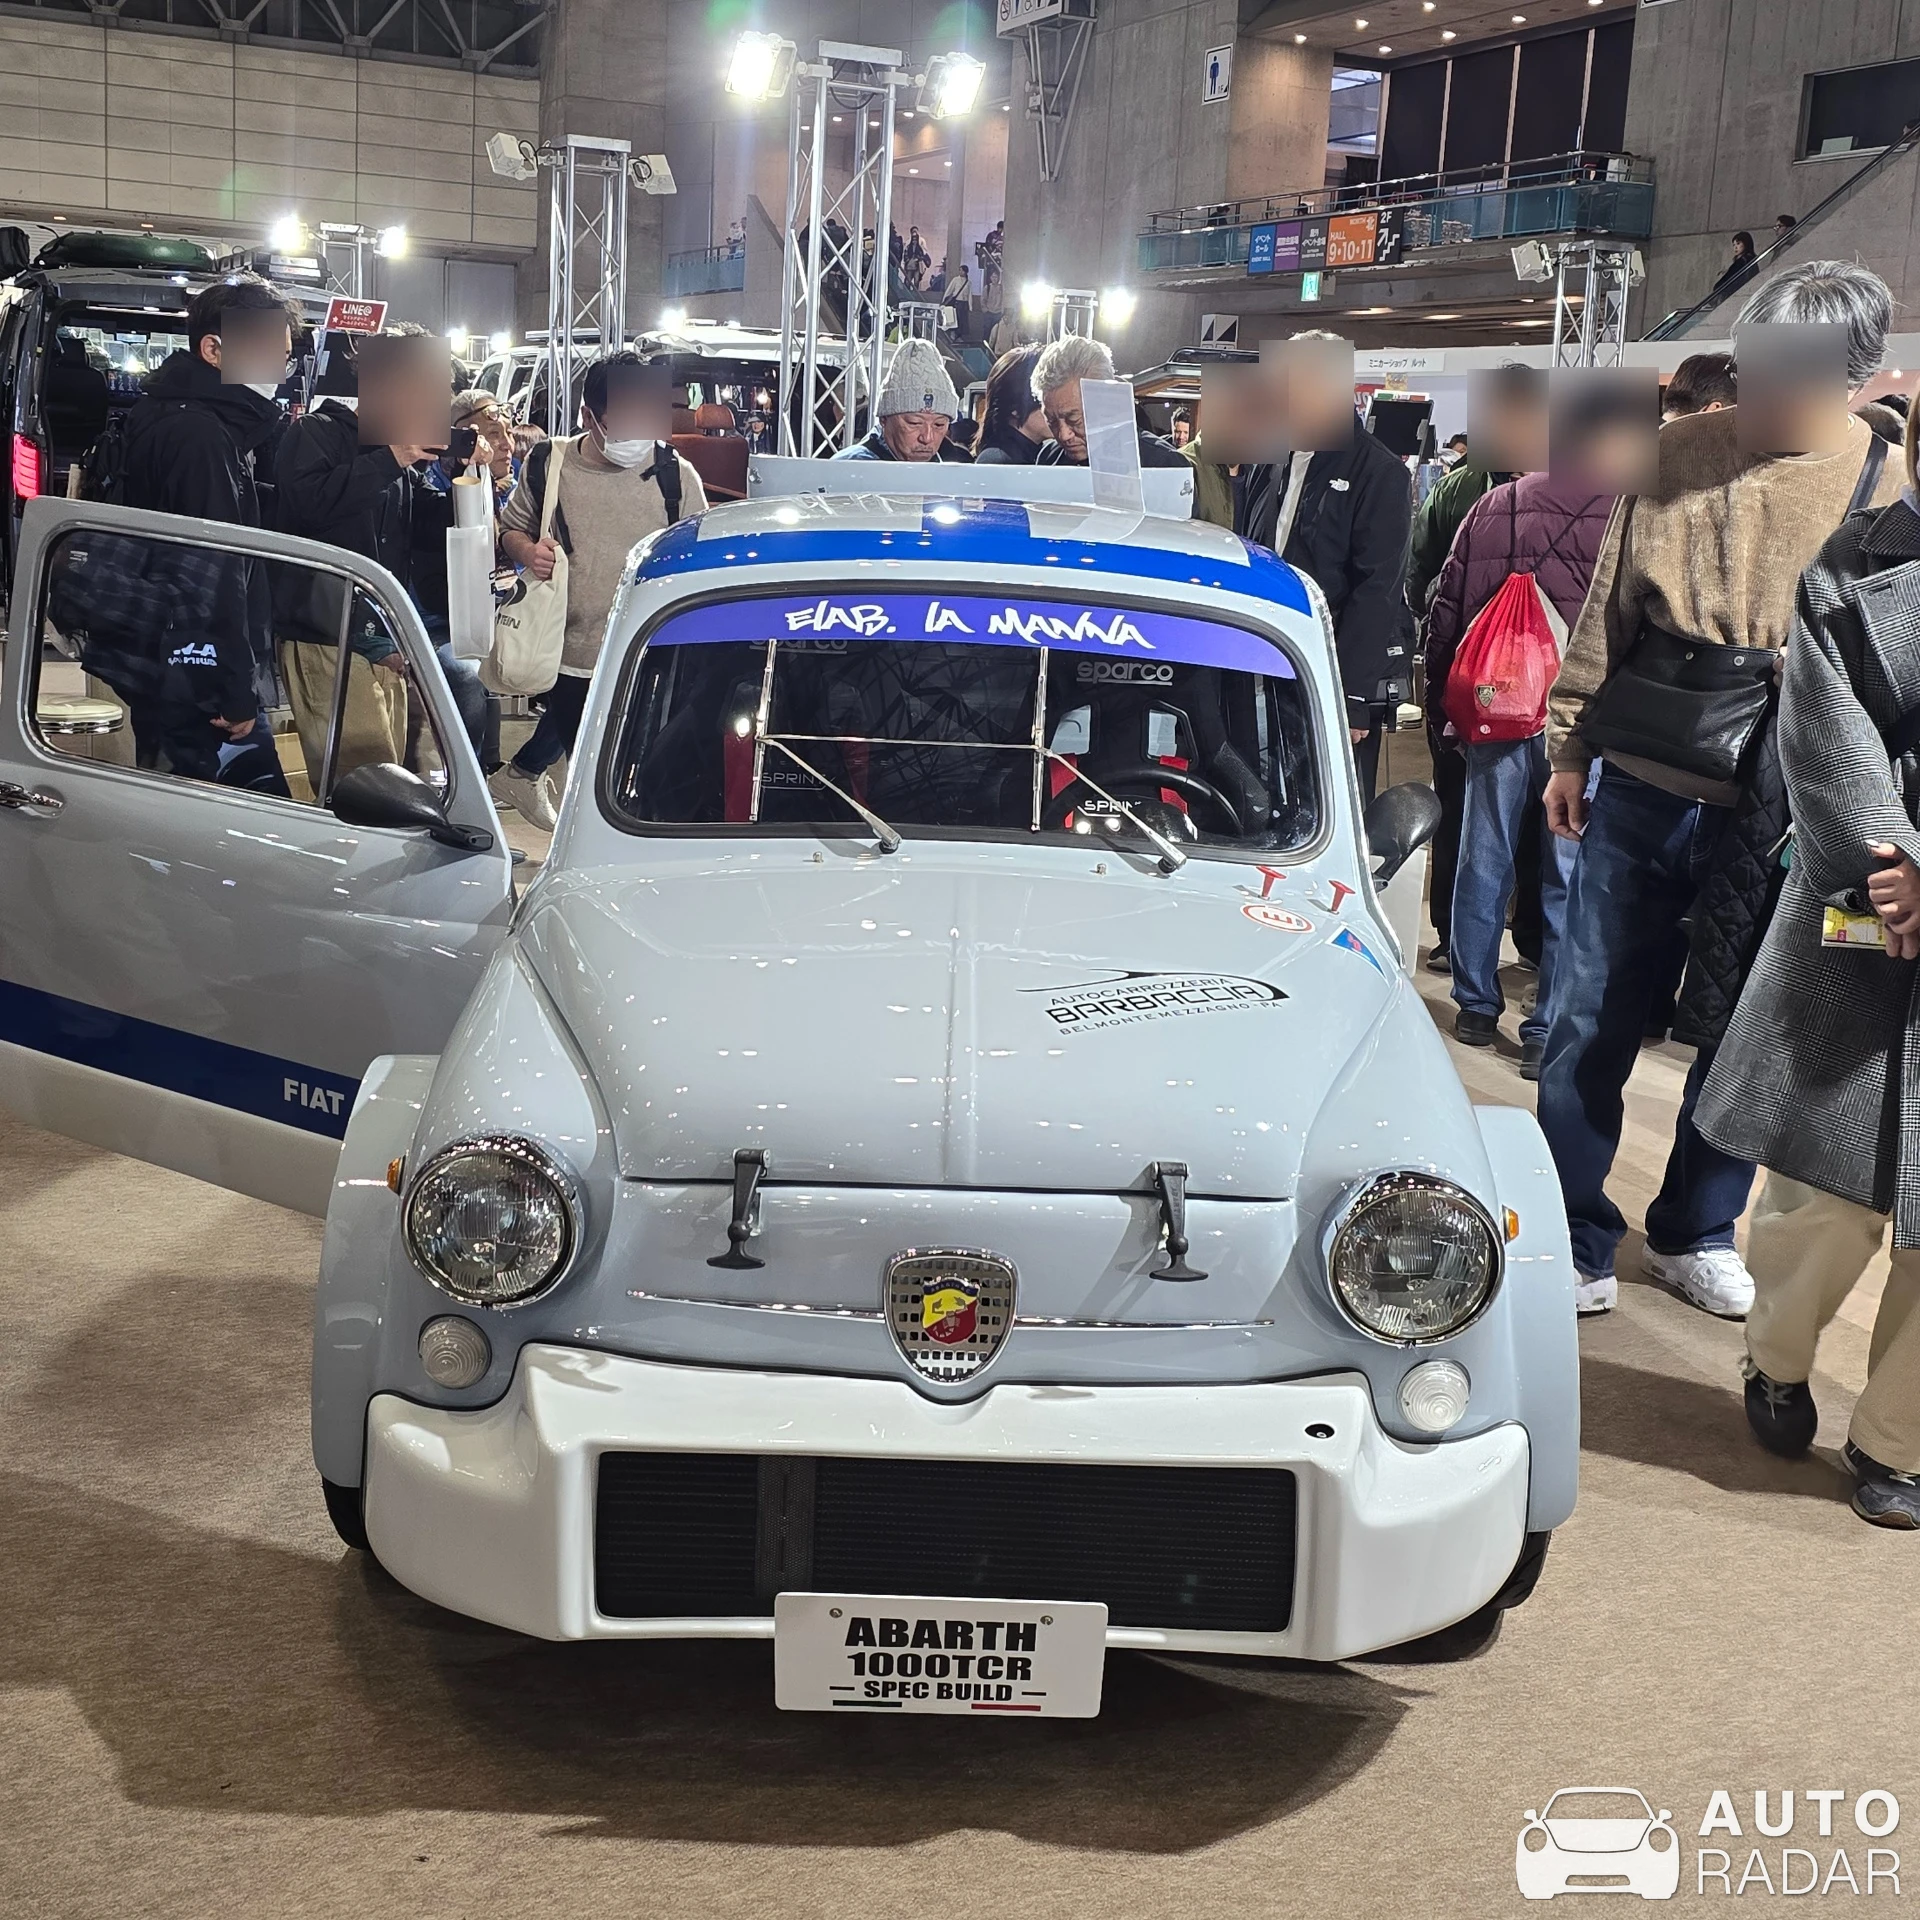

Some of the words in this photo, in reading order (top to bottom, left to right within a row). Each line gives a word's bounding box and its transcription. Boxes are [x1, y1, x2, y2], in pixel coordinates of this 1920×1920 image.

[1380, 211, 1392, 223] 2F
[1330, 231, 1346, 240] HALL
[1077, 661, 1174, 685] sparco
[1045, 986, 1264, 1024] BARBACCIA
[1051, 979, 1234, 1005] AUTOCARROZZERIA
[284, 1077, 345, 1115] FIAT
[845, 1617, 1037, 1652] ABARTH
[847, 1652, 1032, 1681] 1000TCR
[864, 1680, 930, 1698] SPEC
[936, 1683, 1013, 1701] BUILD
